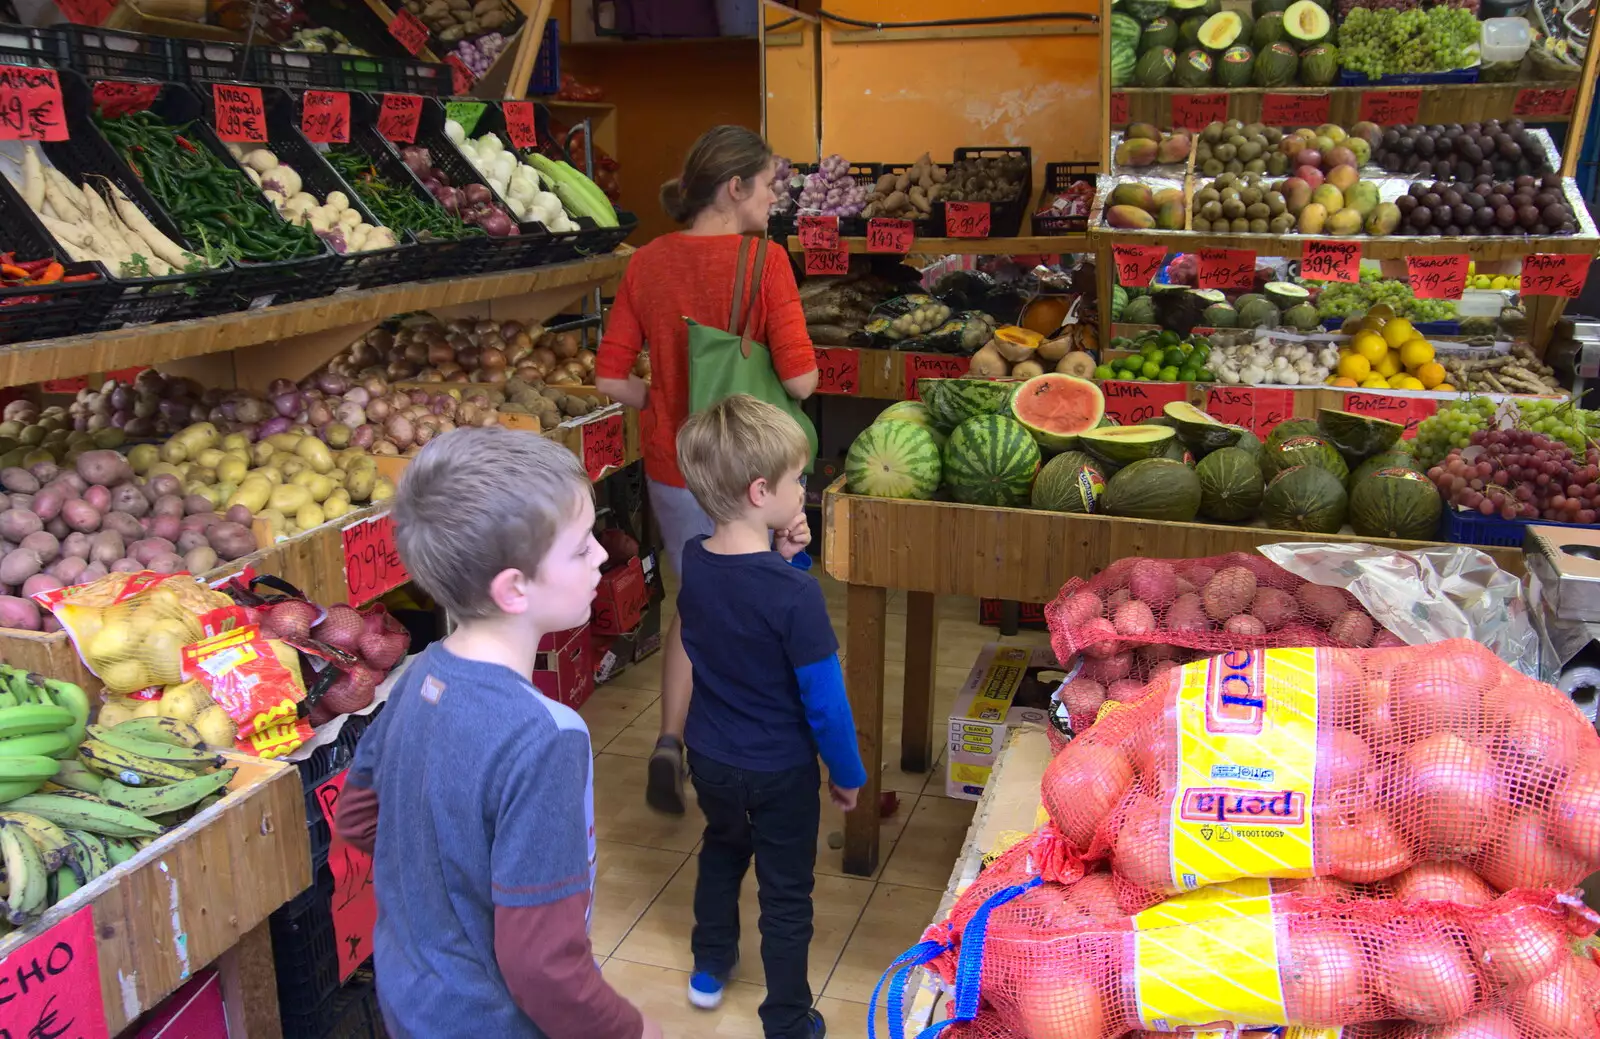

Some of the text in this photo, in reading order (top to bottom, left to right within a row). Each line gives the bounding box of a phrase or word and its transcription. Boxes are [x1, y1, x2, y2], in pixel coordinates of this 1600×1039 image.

[913, 355, 962, 373] PATATA
[1347, 395, 1408, 412] POMELO
[1196, 791, 1294, 821] perla
